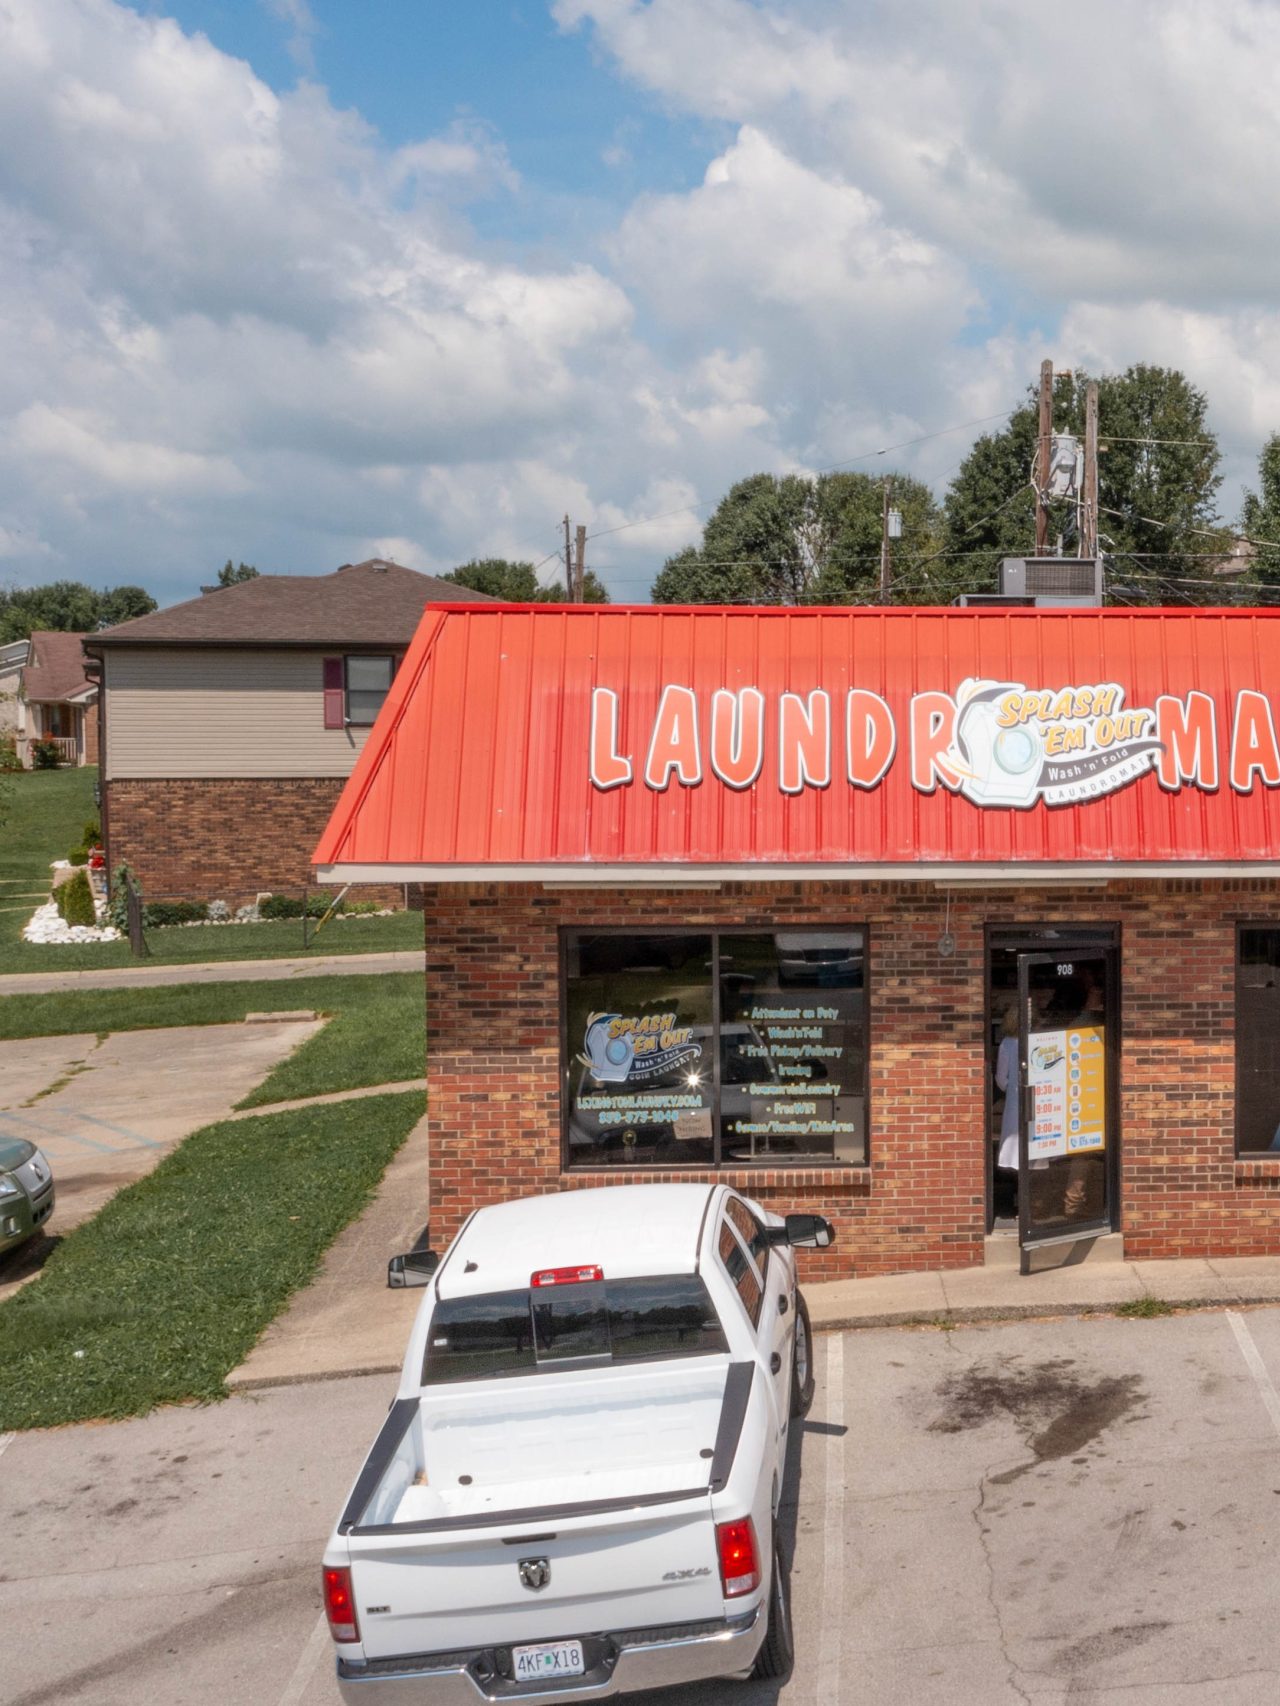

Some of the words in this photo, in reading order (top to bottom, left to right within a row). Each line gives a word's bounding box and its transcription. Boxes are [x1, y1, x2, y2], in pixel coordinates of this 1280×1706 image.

[996, 688, 1118, 728] SPLASH
[1040, 725, 1086, 756] 'EM
[1095, 713, 1149, 747] OUT
[1048, 764, 1082, 781] Wash
[1102, 748, 1129, 765] Fold
[1047, 758, 1147, 800] LAUNDROMAT
[1057, 964, 1073, 976] 908
[608, 1014, 673, 1039] SPLASH
[660, 1028, 691, 1051] OUT
[635, 1059, 654, 1070] Wash
[653, 1054, 691, 1077] LAUNDRY
[518, 1652, 543, 1673] 4KF
[552, 1648, 580, 1669] X18
